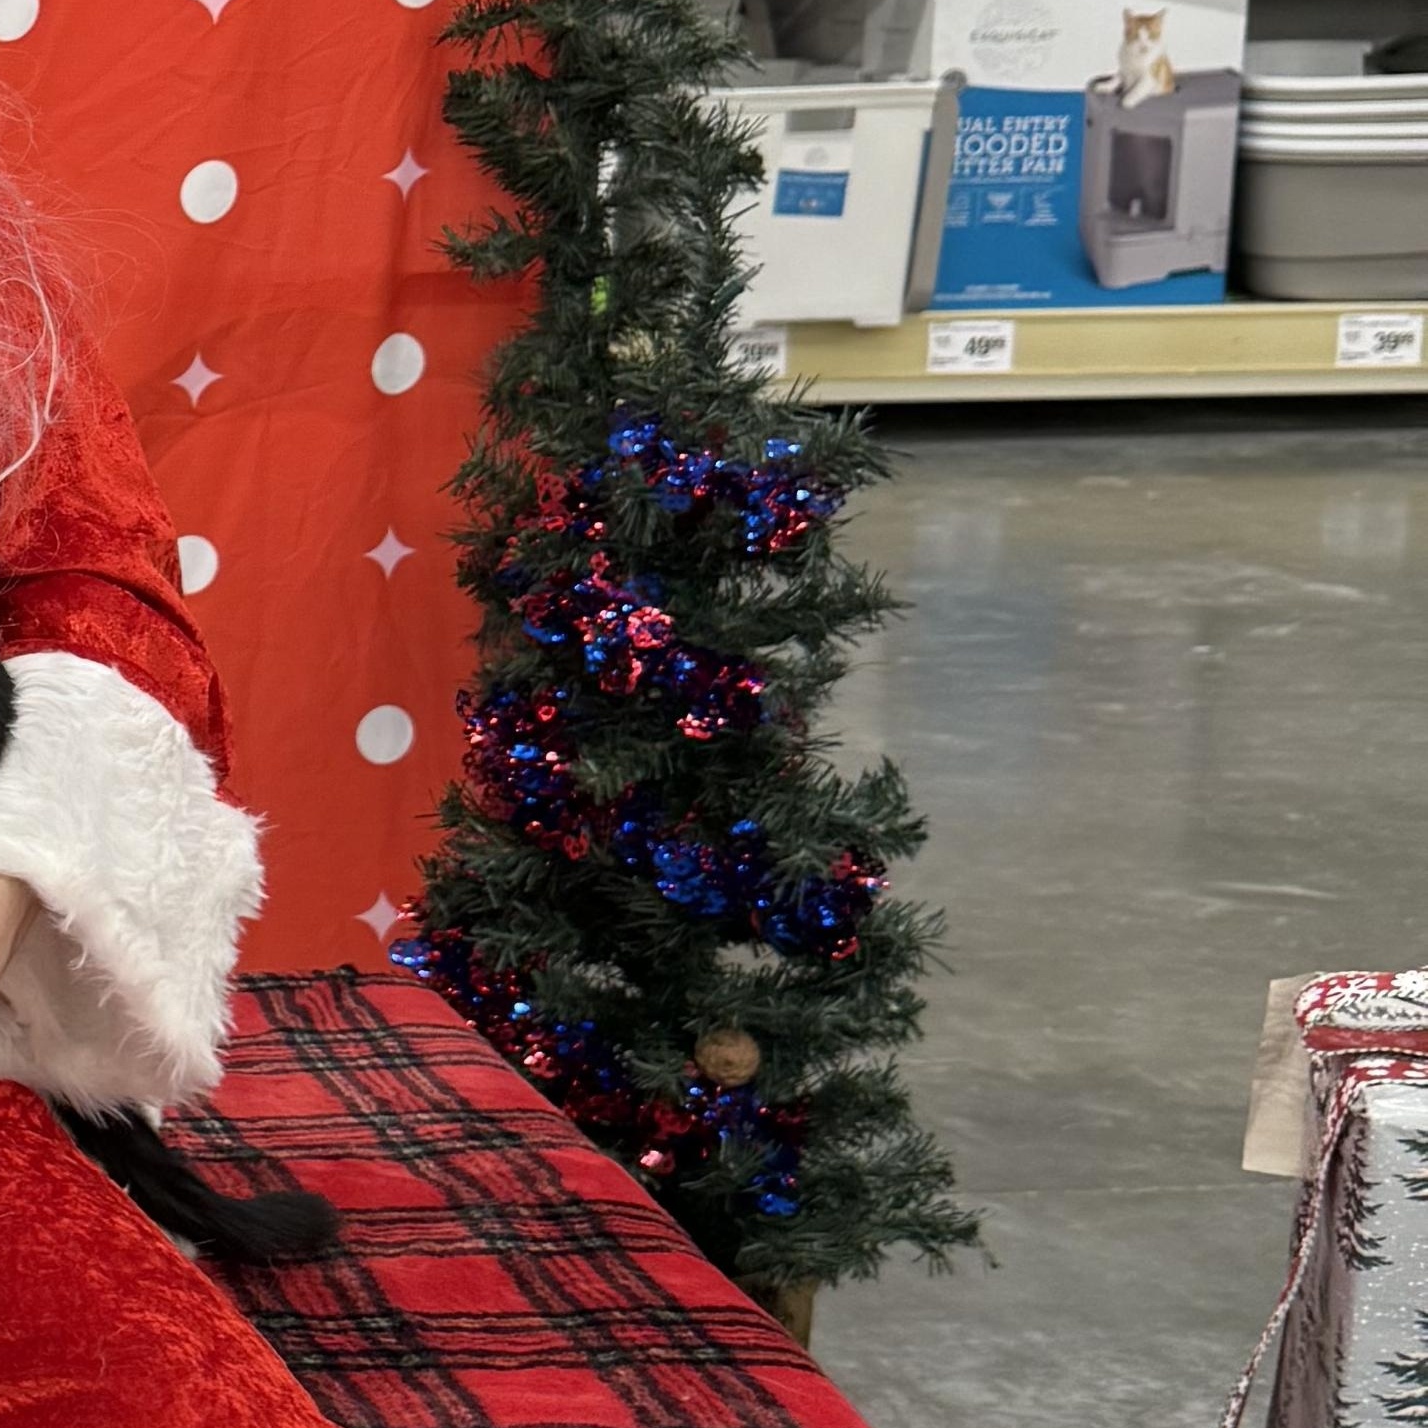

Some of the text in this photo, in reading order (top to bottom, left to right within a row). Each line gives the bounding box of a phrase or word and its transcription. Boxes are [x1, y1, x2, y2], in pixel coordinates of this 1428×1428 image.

[957, 114, 1071, 133] UAL ENTRY
[953, 156, 1065, 174] ITTER PAN
